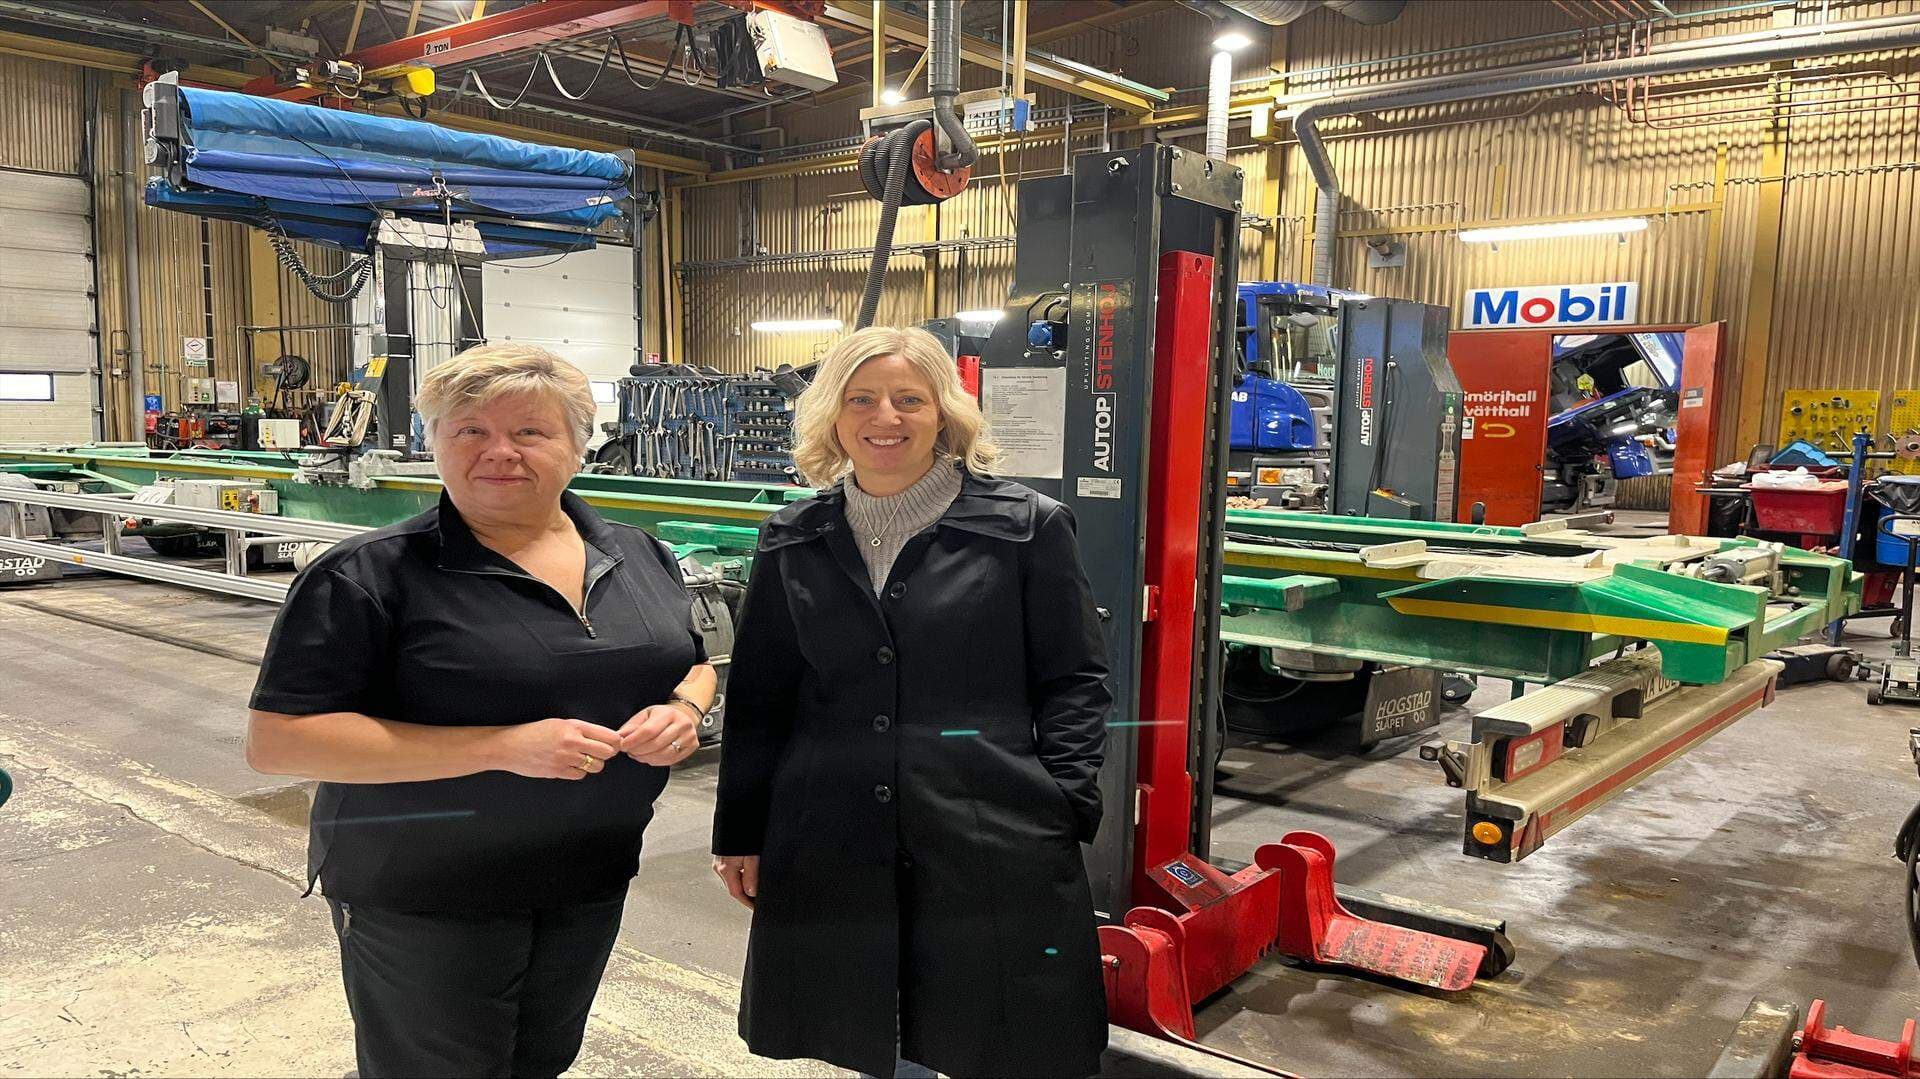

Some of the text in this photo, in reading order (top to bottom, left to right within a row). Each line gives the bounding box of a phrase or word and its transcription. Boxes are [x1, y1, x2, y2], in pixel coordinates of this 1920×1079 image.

[426, 43, 449, 55] 2 TON
[1472, 286, 1627, 325] Mobil
[1094, 396, 1111, 472] AUTOP
[1360, 410, 1370, 446] AUTOP
[1376, 690, 1432, 718] HOGSTAD
